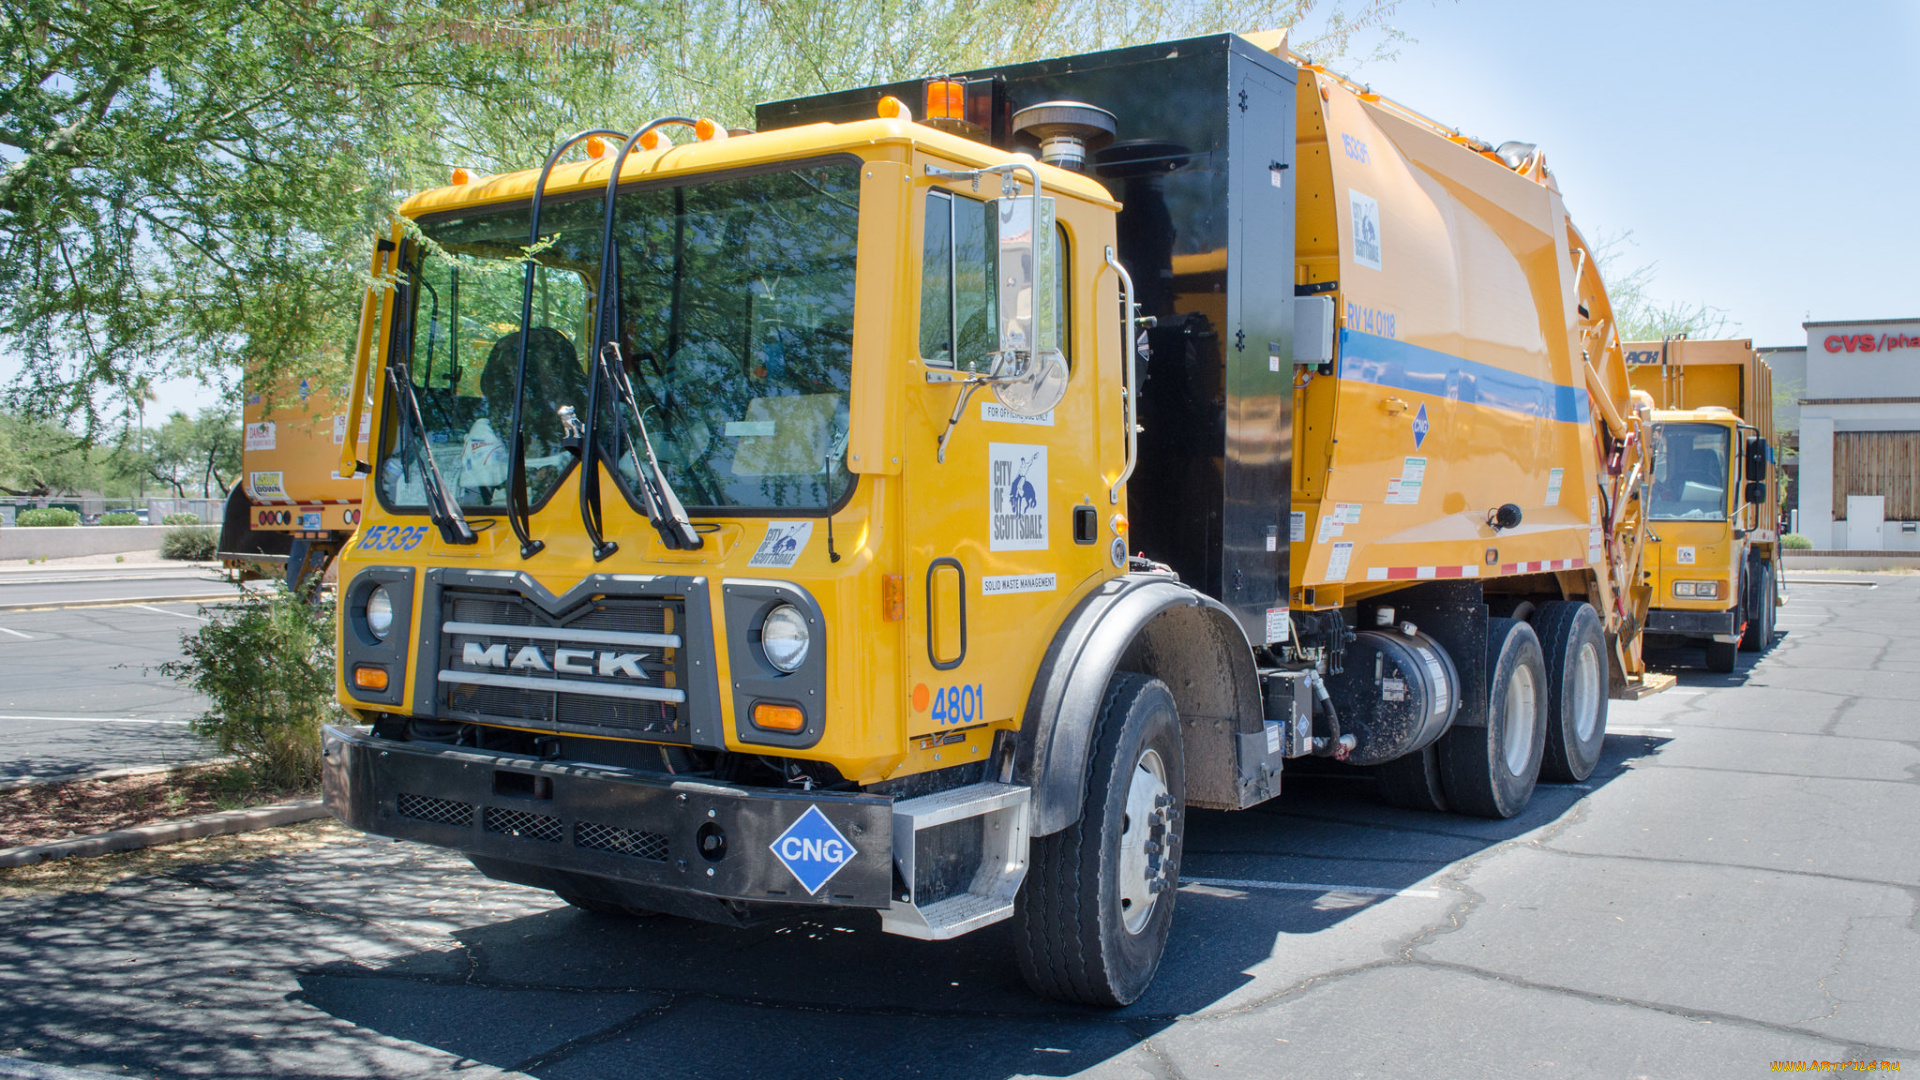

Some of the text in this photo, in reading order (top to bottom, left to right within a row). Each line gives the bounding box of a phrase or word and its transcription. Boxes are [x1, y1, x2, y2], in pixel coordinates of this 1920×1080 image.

[1347, 302, 1395, 338] RV 14 0118
[1624, 351, 1659, 363] ACH
[987, 406, 999, 417] FOR
[1000, 408, 1024, 420] OFFI
[1414, 418, 1428, 433] CNG
[994, 460, 1012, 486] CITY
[994, 487, 1003, 513] OF
[356, 525, 429, 551] 15335
[765, 528, 783, 541] CITY
[994, 514, 1042, 540] SCOTTSDALE
[750, 553, 796, 565] SCOTTSDALE
[758, 541, 771, 553] OF
[984, 577, 1055, 591] SOLID WASTE MANAGEMENT
[463, 642, 650, 680] MACK
[931, 683, 983, 725] 4801
[781, 836, 844, 863] CNG
